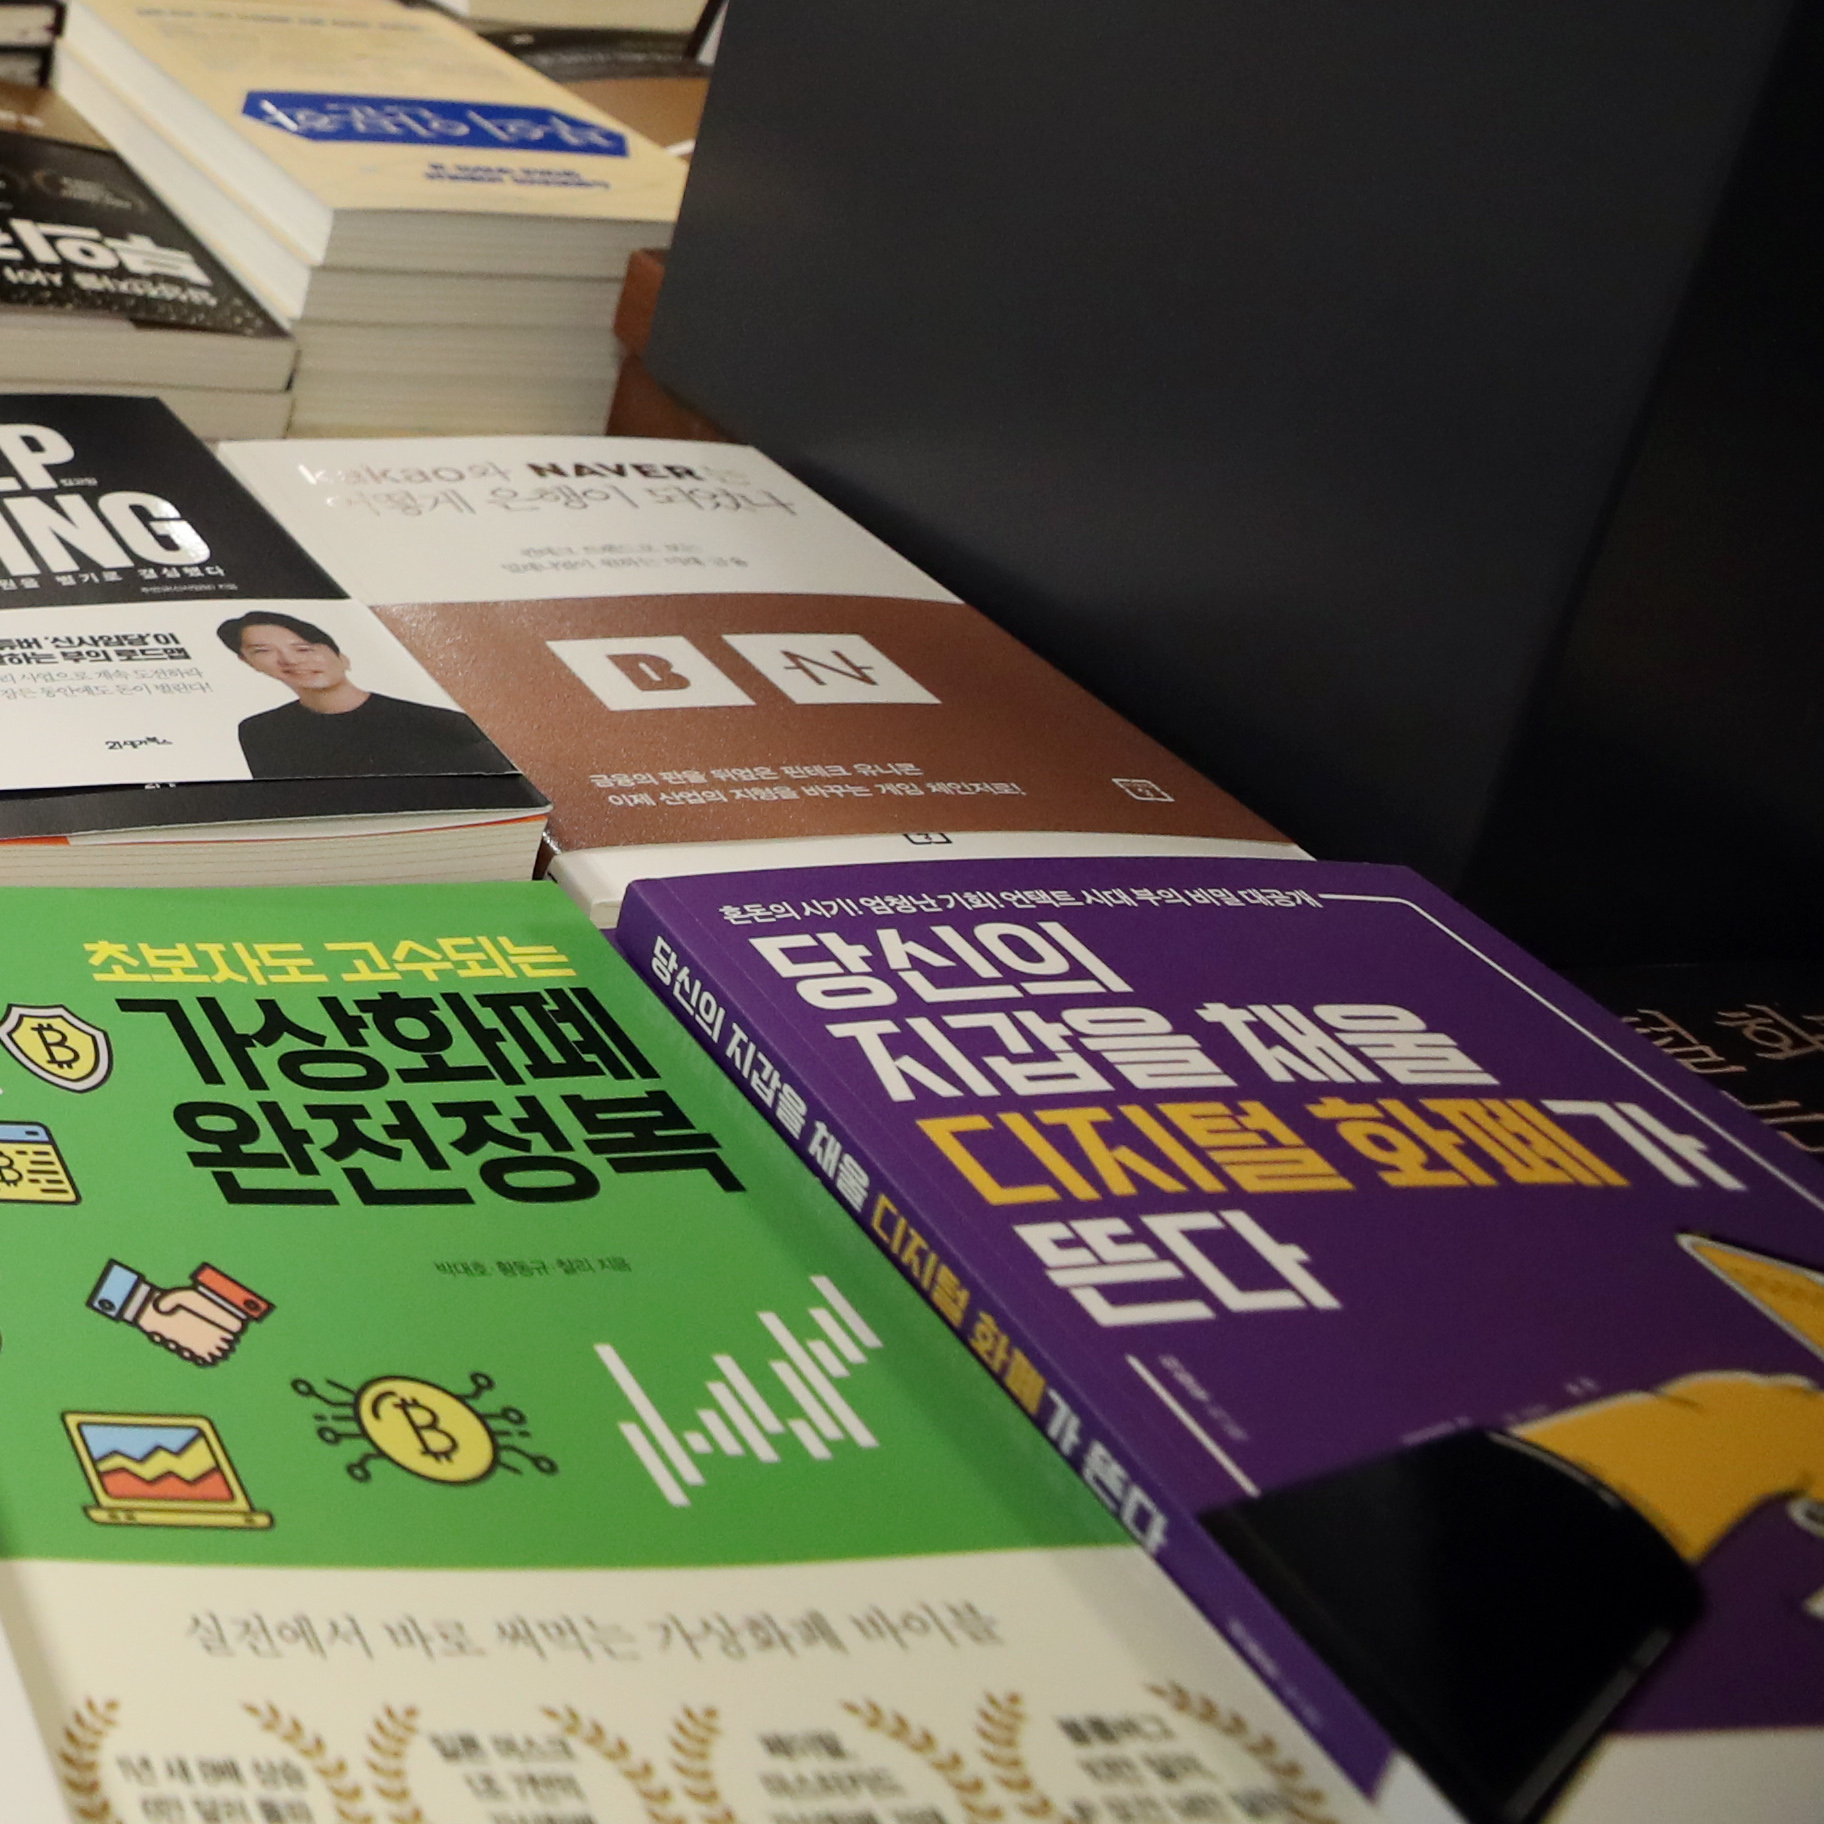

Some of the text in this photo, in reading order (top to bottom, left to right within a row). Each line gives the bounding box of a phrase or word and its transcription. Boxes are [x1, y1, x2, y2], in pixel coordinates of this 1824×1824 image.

[62, 651, 112, 664] 부의
[117, 647, 191, 661] 로드맵
[609, 780, 1025, 808] 이제 산업의 지형을 바꾸는 게임 체인저로!
[719, 885, 1323, 925] 혼돈의 시기! 엄청난 기회! 언택트 시대 부의 비밀 대공개
[82, 933, 577, 986] 초보자도 고수되는
[749, 918, 1136, 1012] 당신의
[113, 986, 663, 1094] 가상화폐
[825, 1003, 1503, 1104] 지갑을 채울
[170, 1089, 747, 1206] 완전정복
[917, 1097, 1748, 1209] 디지털 화폐가
[649, 935, 726, 1045] 당신의
[724, 1023, 808, 1136] 지갑을
[807, 1109, 870, 1192] 채울
[870, 1192, 967, 1328] 디지털
[1079, 1437, 1168, 1560] 뜬다
[1014, 1209, 1342, 1328] 뜬다
[188, 1601, 1003, 1661] 실전에서 바로 써먹는 가상화폐 바이블
